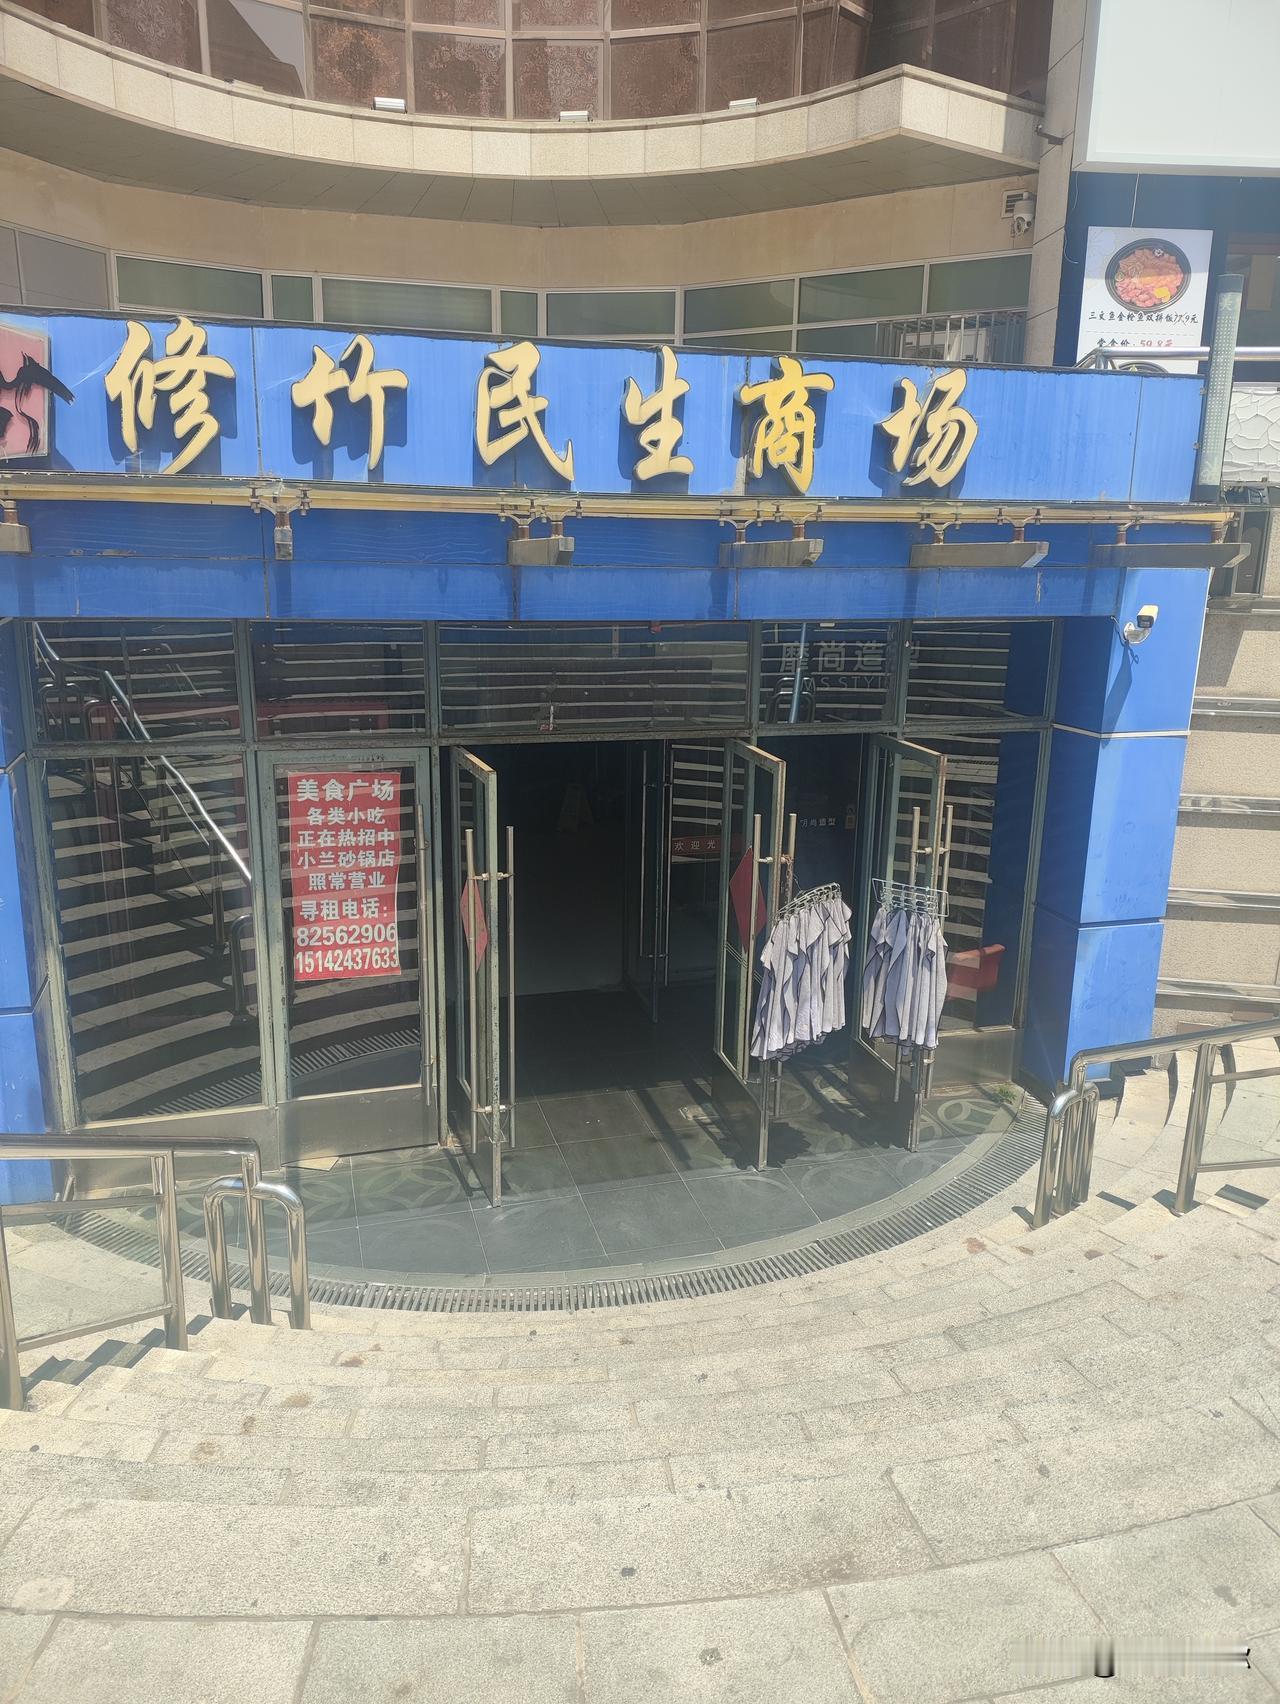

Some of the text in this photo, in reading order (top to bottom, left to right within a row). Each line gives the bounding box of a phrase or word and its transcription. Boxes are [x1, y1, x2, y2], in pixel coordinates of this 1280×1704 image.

[105, 316, 979, 494] 修竹民生商场
[297, 779, 394, 801] 美食广场
[307, 807, 385, 825] 各类小吃
[298, 829, 395, 847] 正在热招中
[298, 849, 395, 869] 小兰砂锅店
[308, 871, 385, 890] 照常营业
[300, 898, 388, 921] 寻租电话：
[297, 923, 396, 946] 82562906
[296, 946, 399, 973] 15142437633
